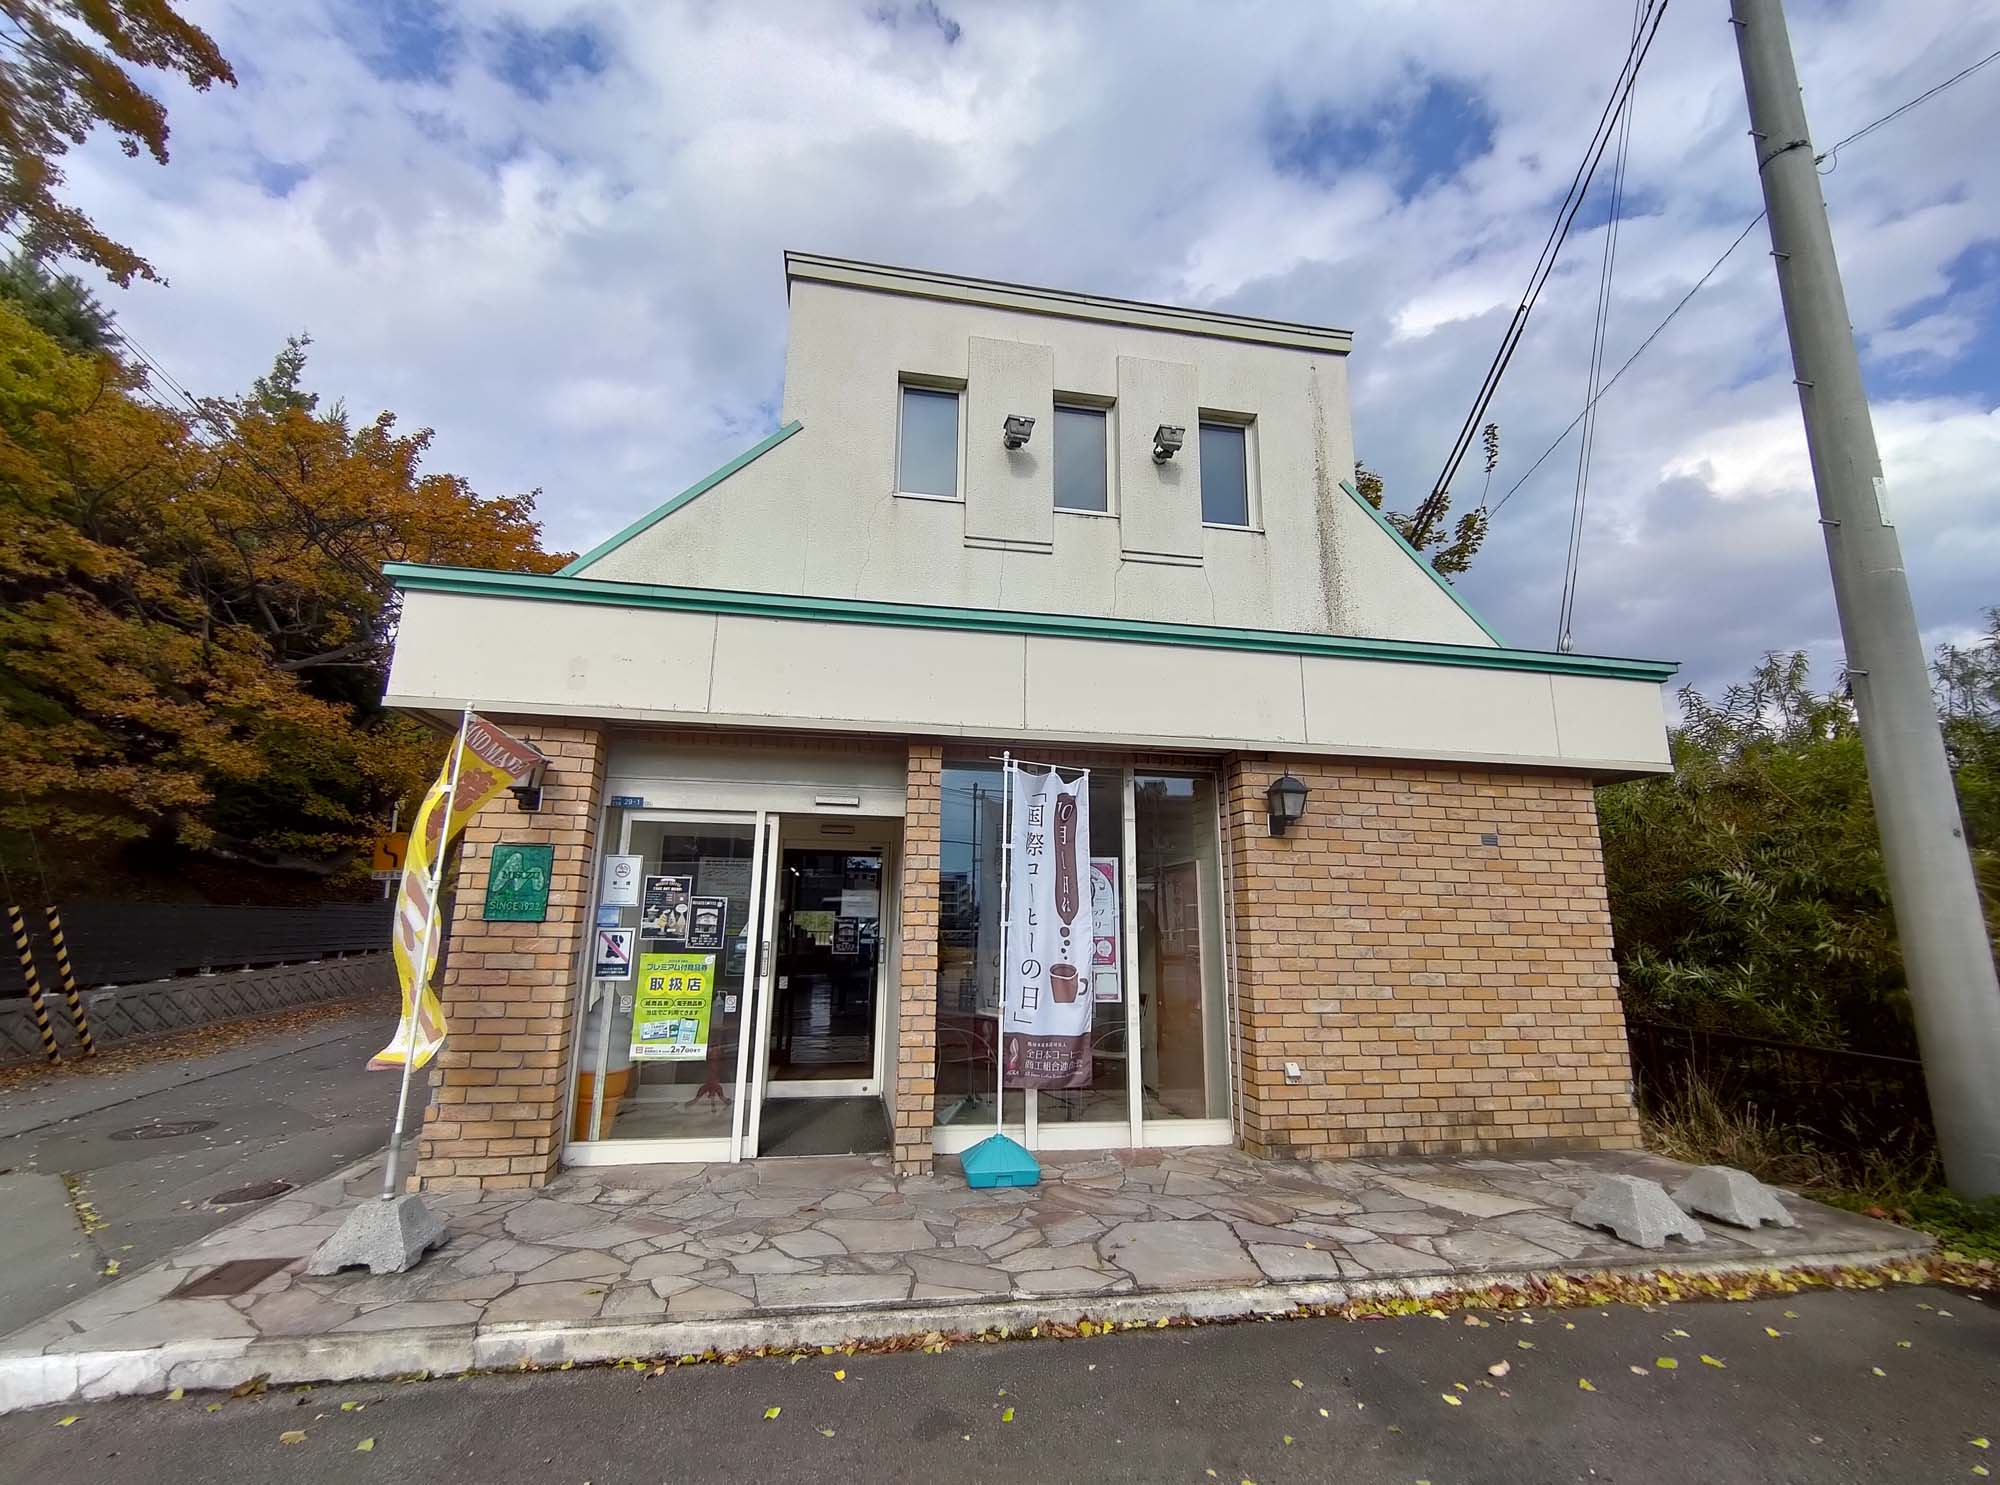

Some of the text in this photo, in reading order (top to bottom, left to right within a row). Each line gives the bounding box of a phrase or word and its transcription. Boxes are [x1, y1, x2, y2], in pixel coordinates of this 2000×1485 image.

[490, 901, 518, 911] SINCE
[650, 977, 702, 991] 取扱店
